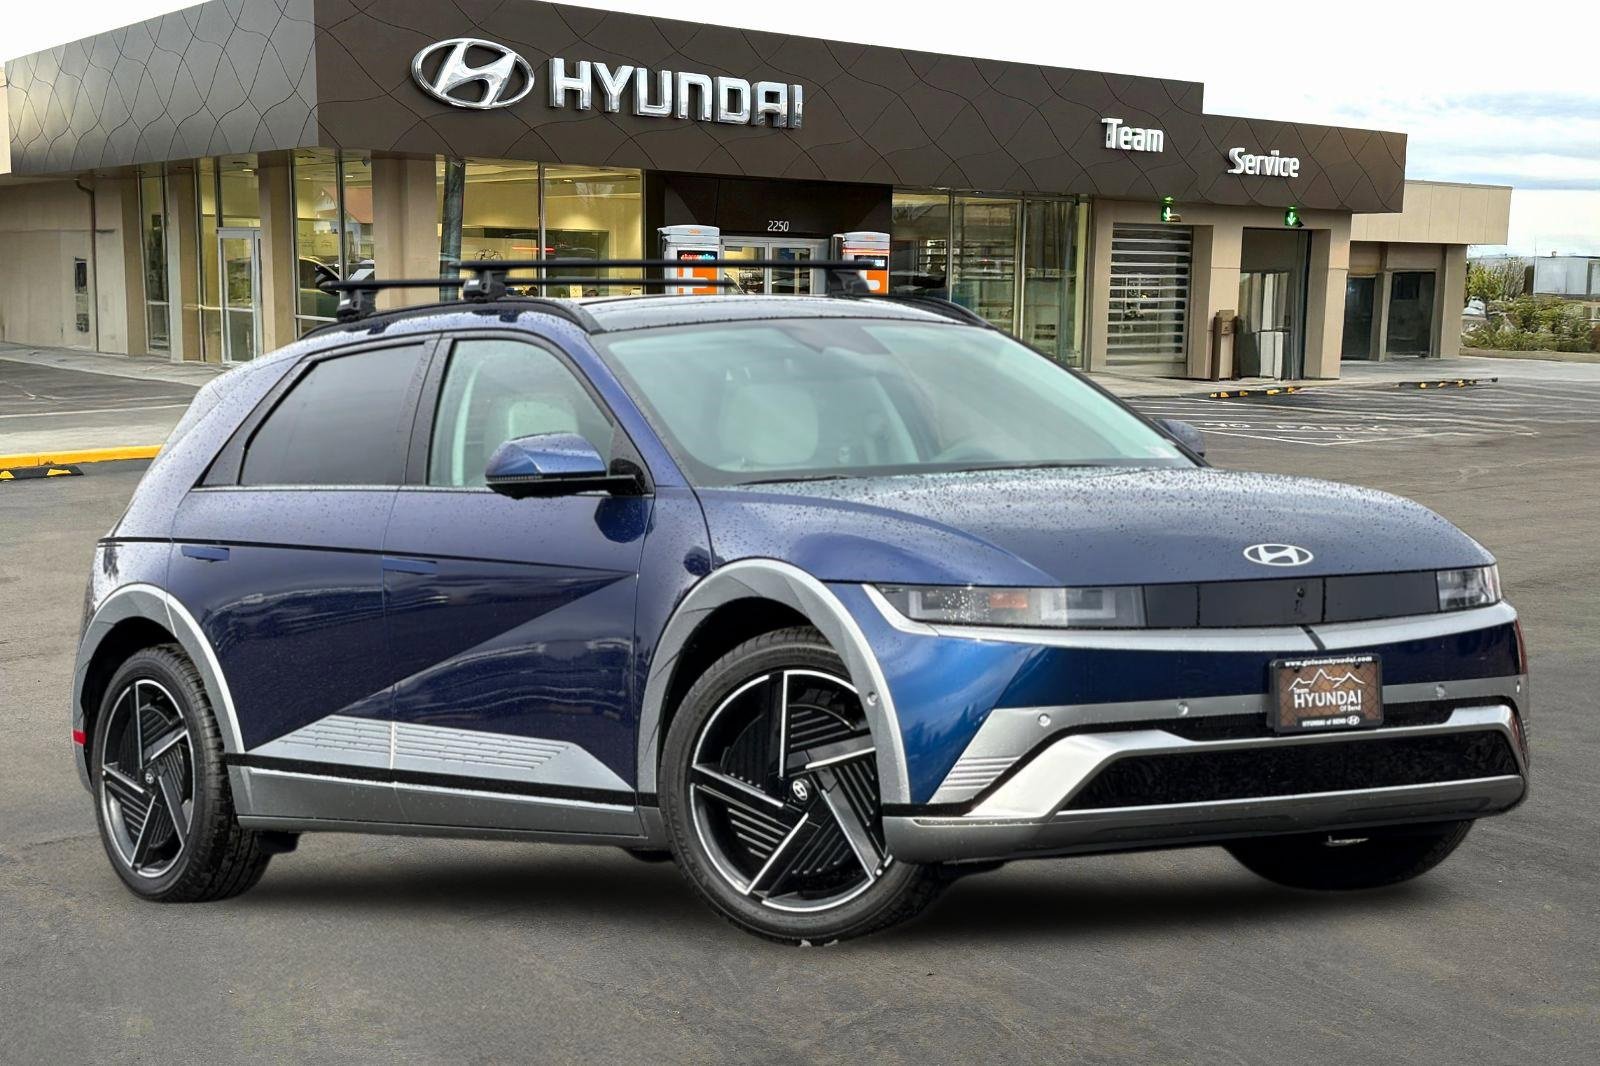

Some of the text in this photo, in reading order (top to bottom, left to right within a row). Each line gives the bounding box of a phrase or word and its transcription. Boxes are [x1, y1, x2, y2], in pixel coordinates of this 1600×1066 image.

[549, 57, 802, 129] HYUNDAI
[1101, 117, 1164, 152] Team
[1227, 147, 1300, 177] Service
[767, 220, 790, 232] 2250
[1294, 689, 1362, 709] HYUNDAI
